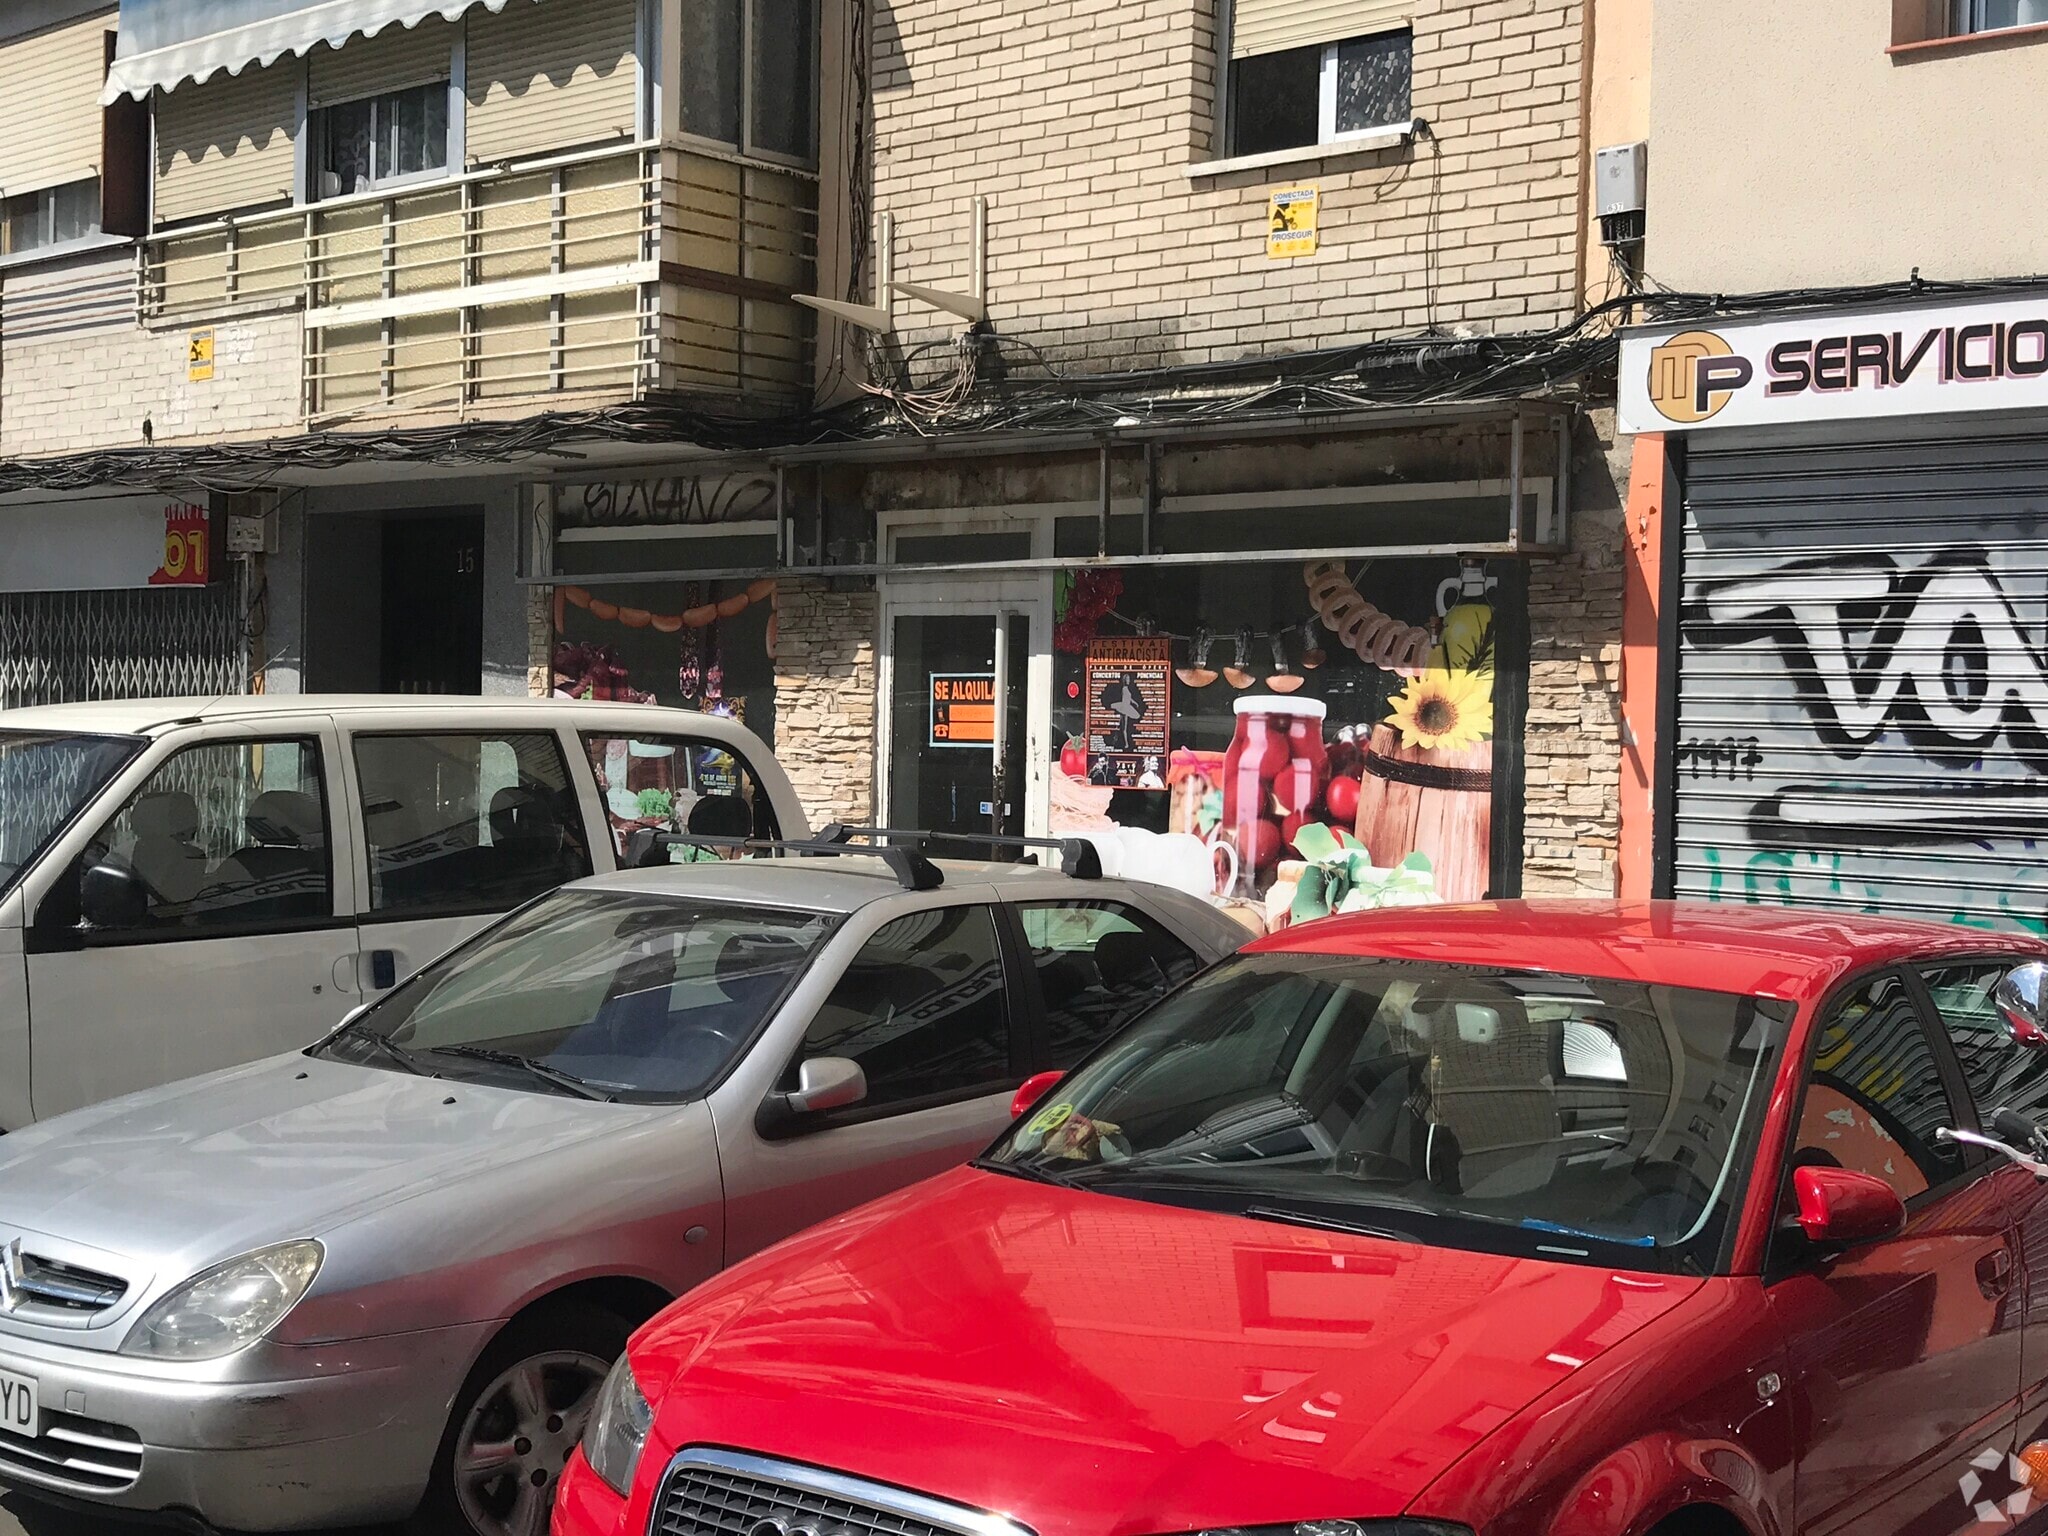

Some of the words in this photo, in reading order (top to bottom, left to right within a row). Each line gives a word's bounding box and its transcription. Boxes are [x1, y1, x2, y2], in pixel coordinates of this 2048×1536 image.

[1273, 189, 1314, 200] CONECTADA
[1271, 230, 1313, 241] PROSEGUR
[457, 548, 474, 573] 15
[934, 680, 949, 700] SE
